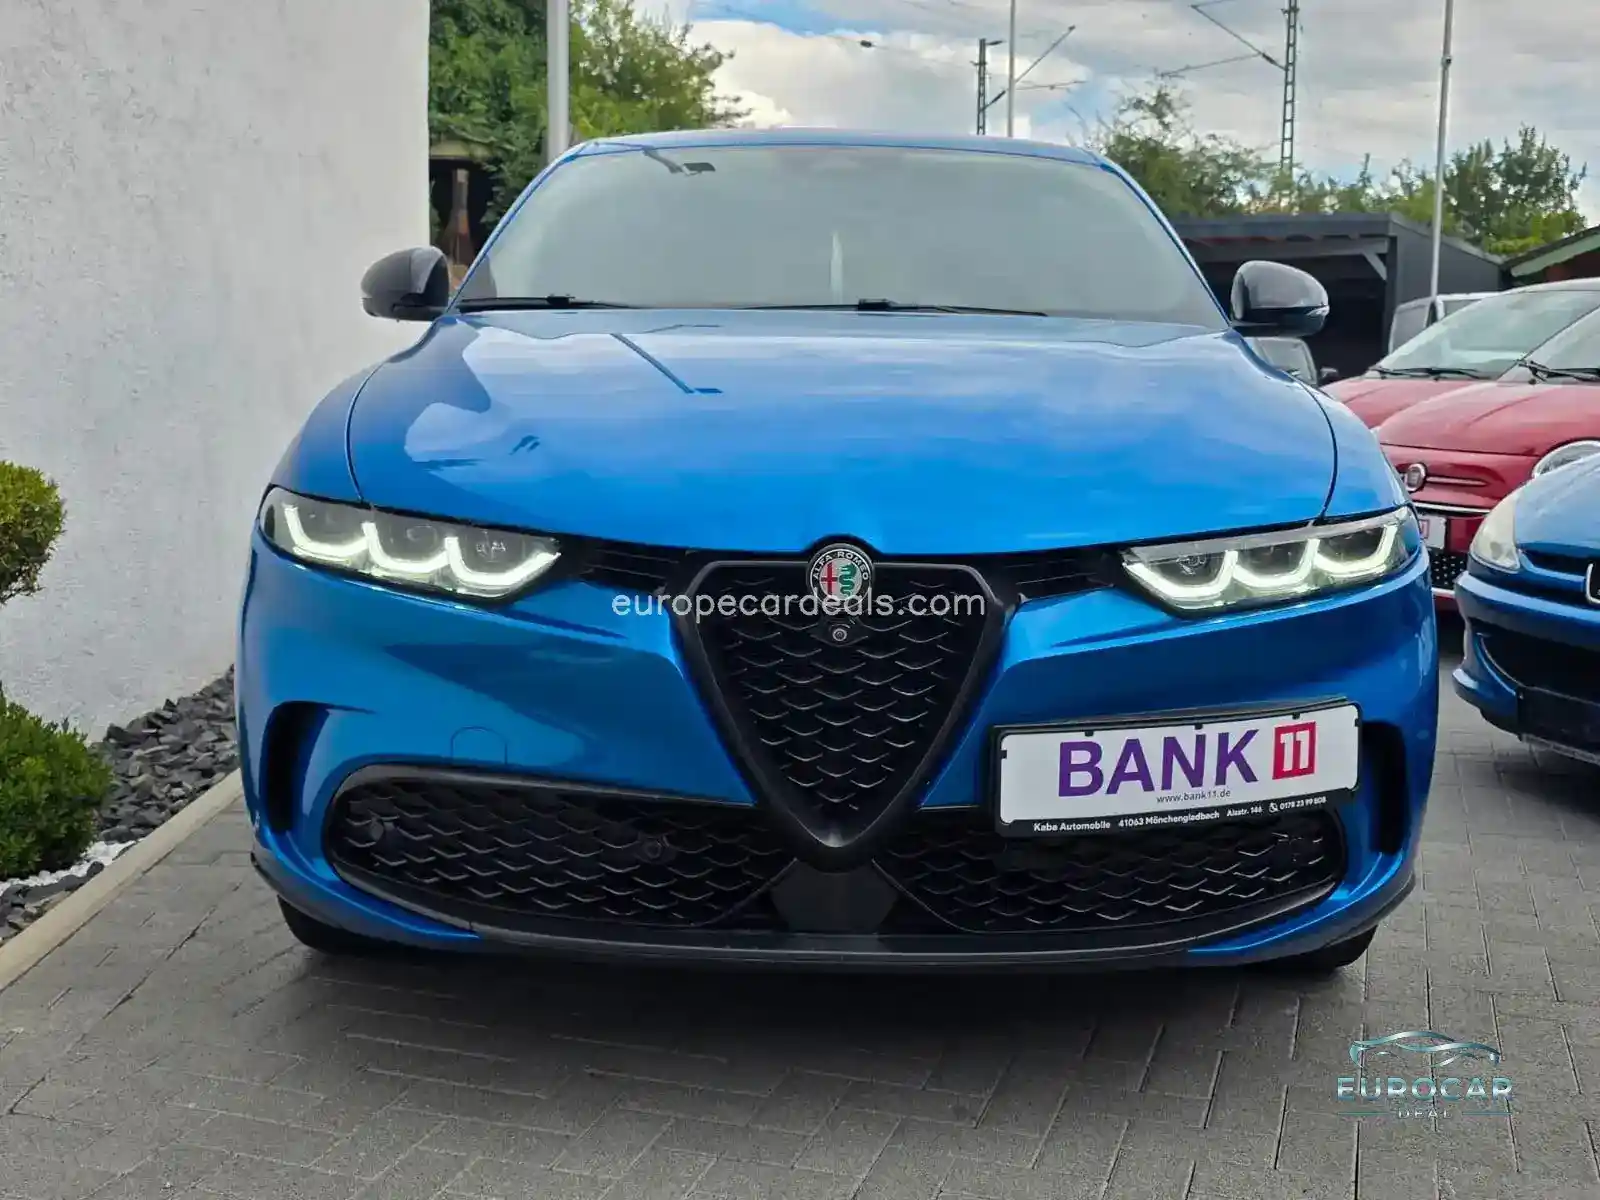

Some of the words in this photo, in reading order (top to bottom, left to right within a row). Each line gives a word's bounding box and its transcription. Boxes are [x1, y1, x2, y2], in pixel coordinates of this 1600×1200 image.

[812, 554, 833, 580] ALFA
[837, 551, 869, 580] ROMEO
[1058, 729, 1259, 797] BANK
[1280, 730, 1308, 773] 11
[1156, 788, 1231, 803] www.bank11.de
[1059, 820, 1111, 831] Automobile
[1118, 817, 1144, 827] 41063
[1145, 811, 1220, 825] Mönchengladbach
